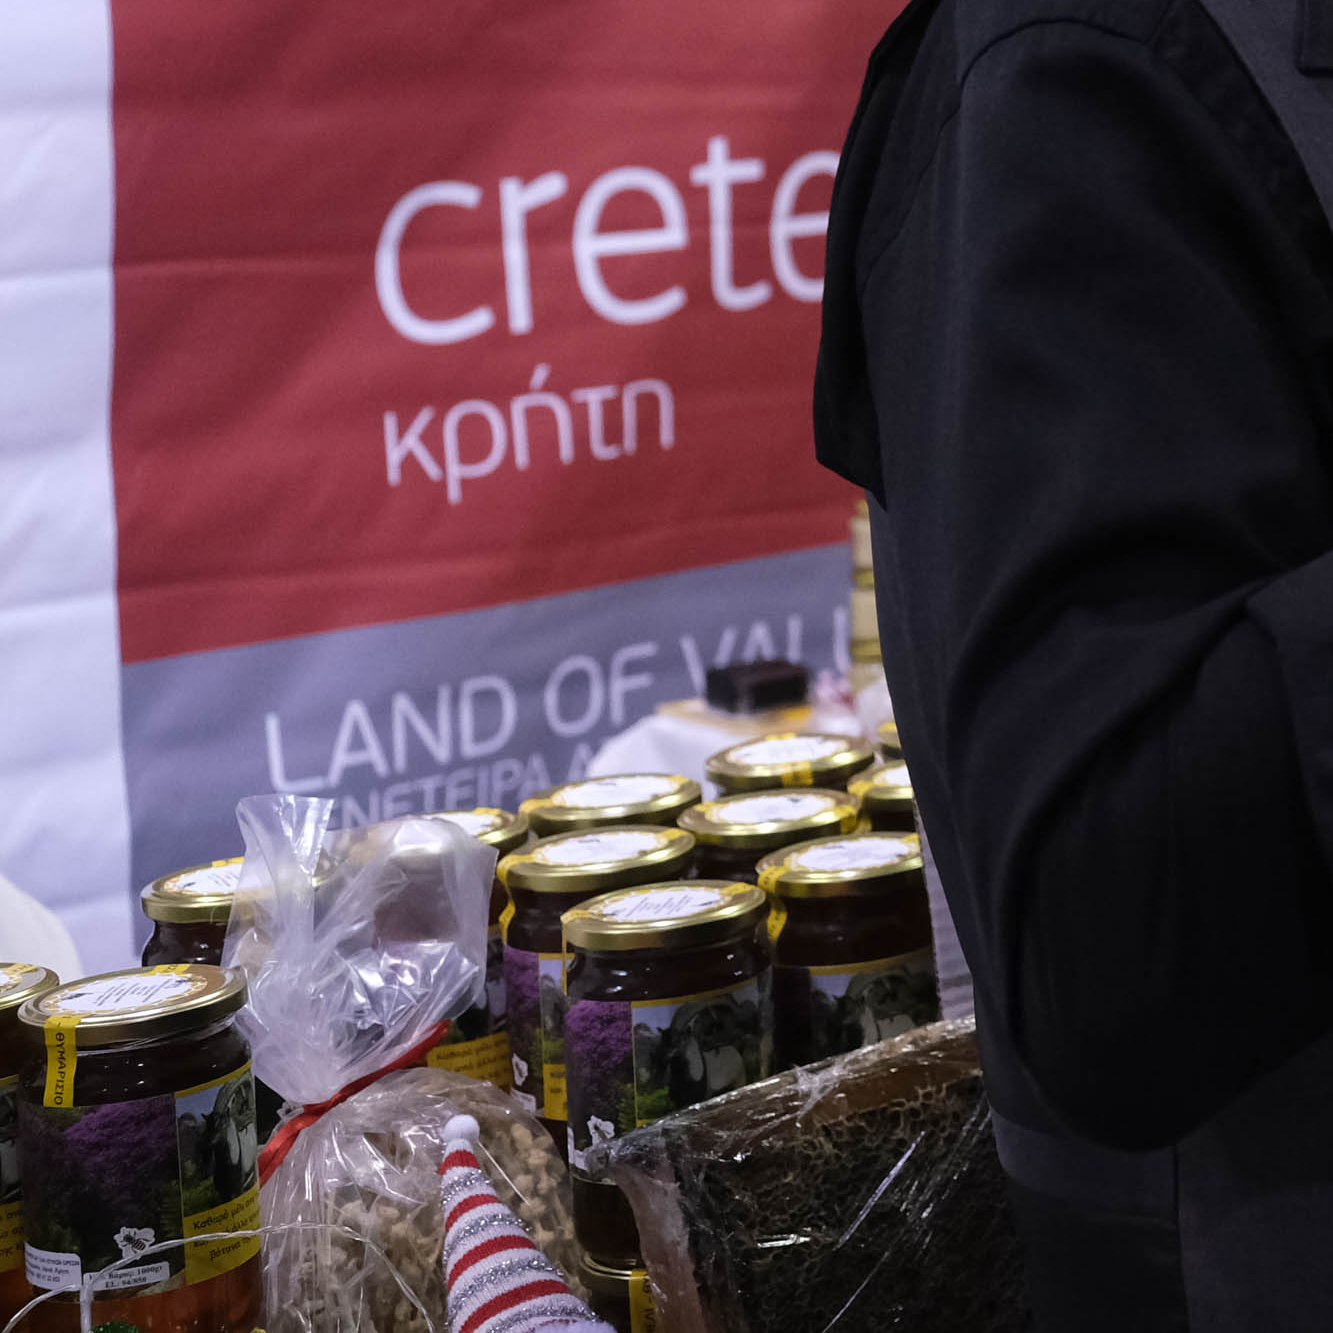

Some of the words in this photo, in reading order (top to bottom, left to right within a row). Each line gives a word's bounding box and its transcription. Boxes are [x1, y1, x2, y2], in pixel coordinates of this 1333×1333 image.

[374, 134, 842, 346] crete
[383, 362, 676, 506] κρήτη
[264, 673, 519, 794] LAND
[543, 640, 660, 738] OF
[53, 1031, 66, 1107] ΘΥΜΑΡΙΣΙΟ
